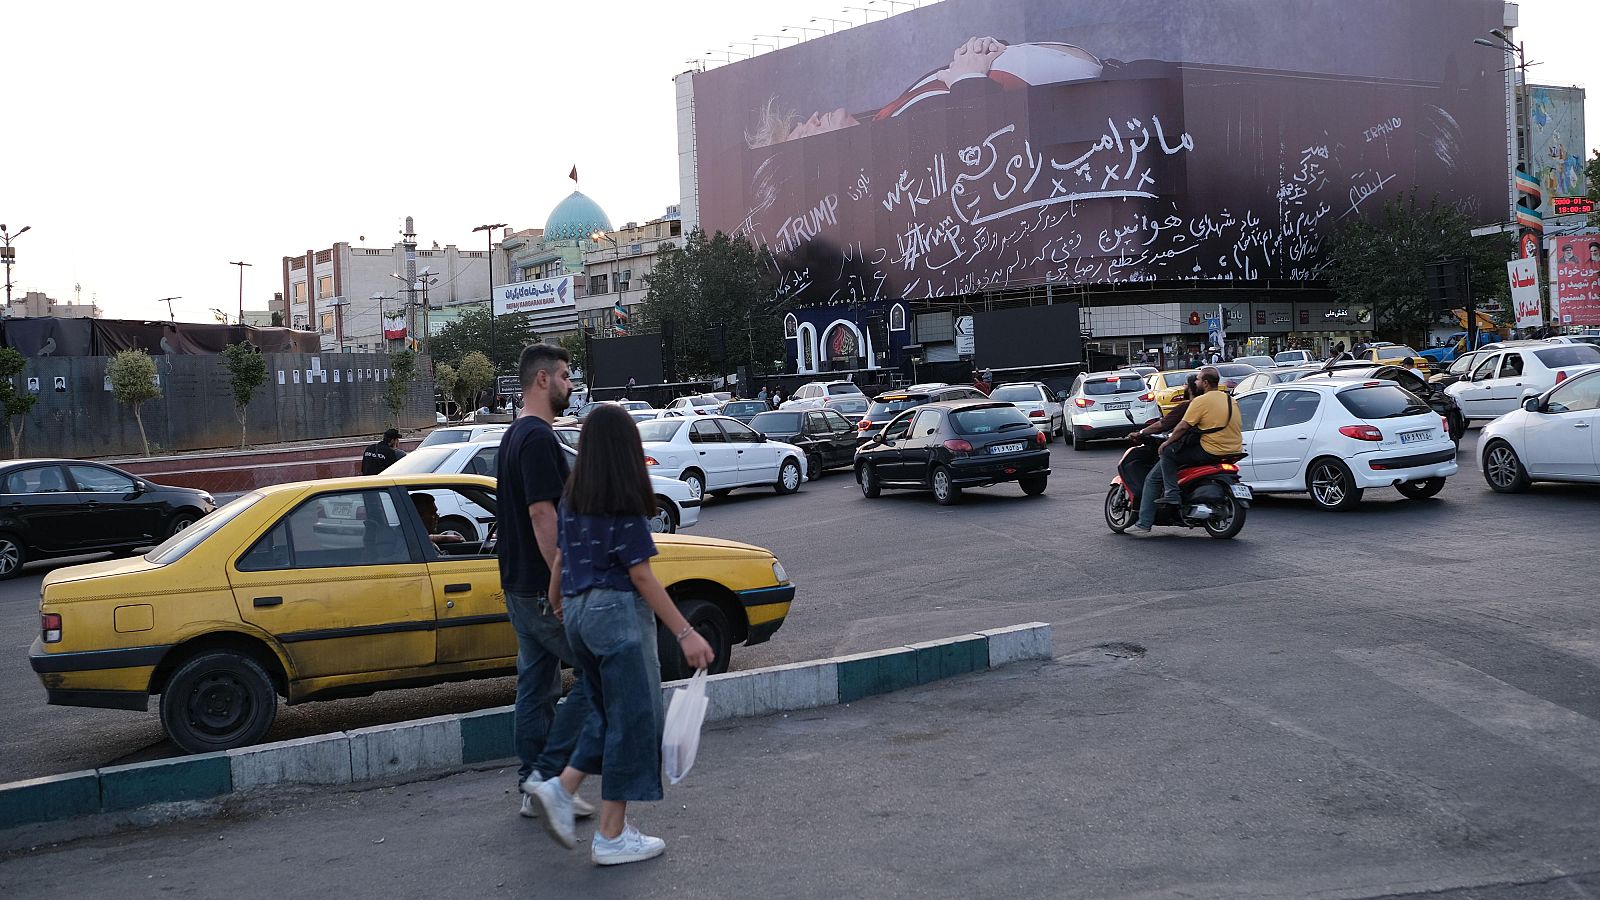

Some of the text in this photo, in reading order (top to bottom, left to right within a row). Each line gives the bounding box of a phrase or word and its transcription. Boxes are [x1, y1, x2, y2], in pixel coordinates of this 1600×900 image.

[1051, 117, 1149, 182] ترامپ
[775, 193, 838, 251] TRUMP
[539, 283, 554, 296] بانک
[1567, 278, 1589, 289] شهید
